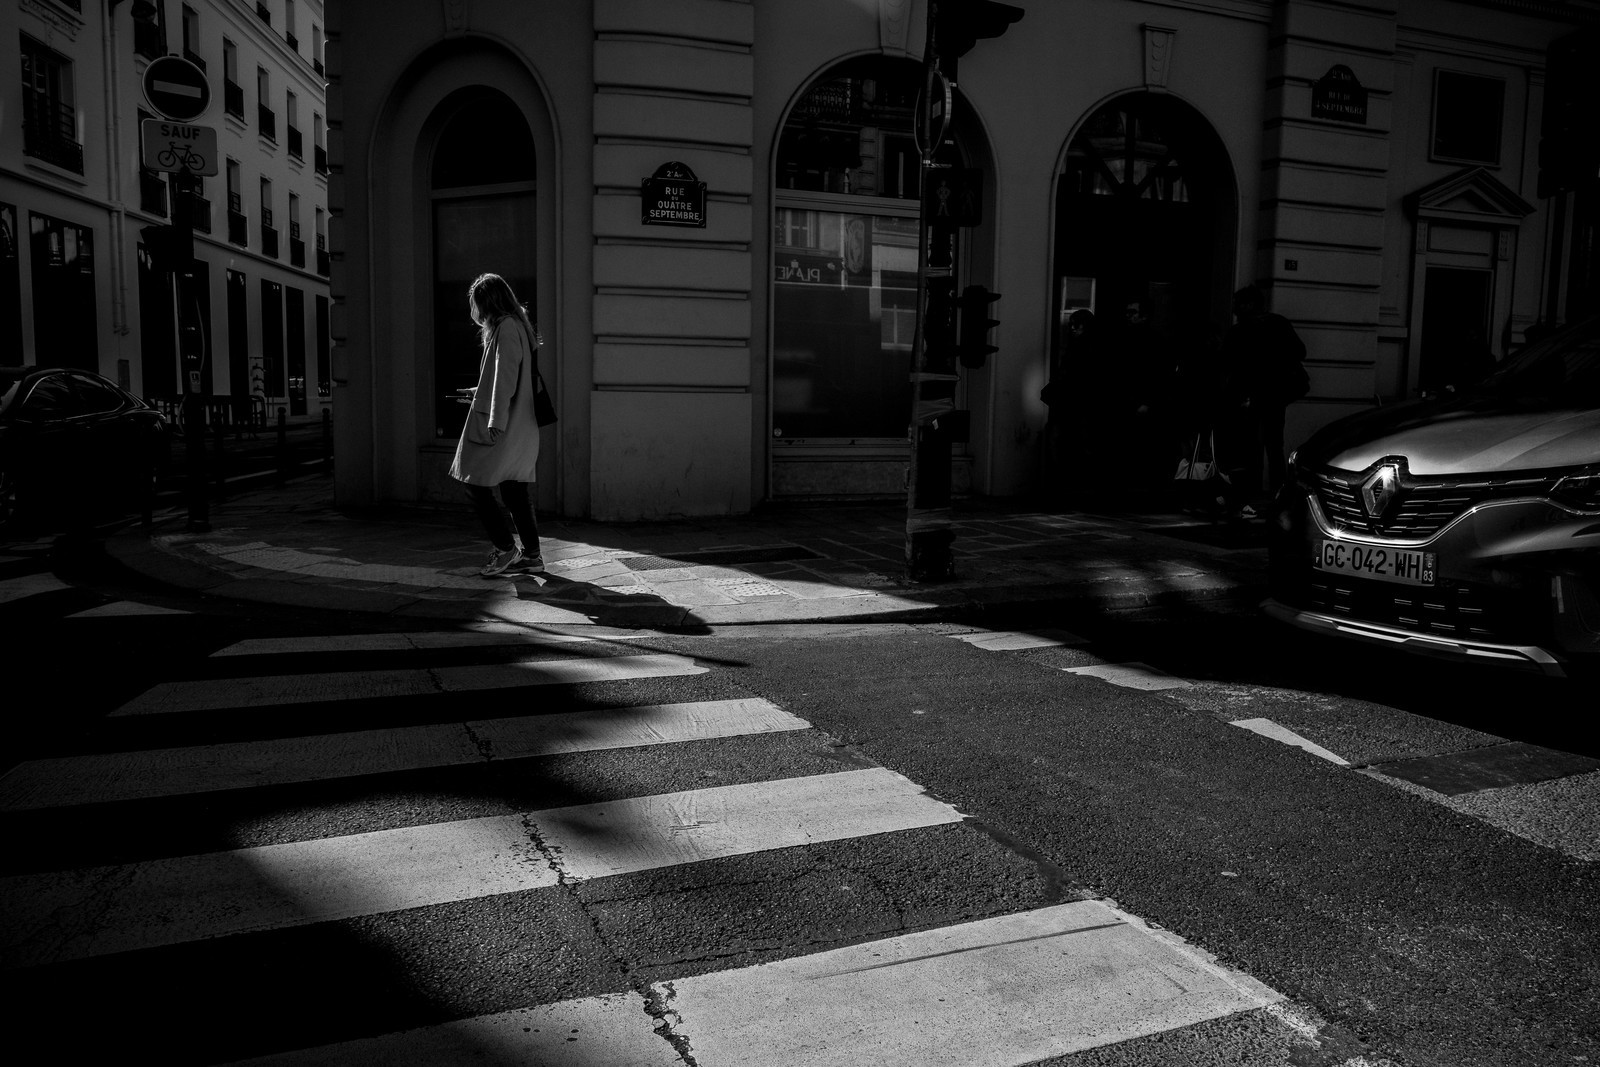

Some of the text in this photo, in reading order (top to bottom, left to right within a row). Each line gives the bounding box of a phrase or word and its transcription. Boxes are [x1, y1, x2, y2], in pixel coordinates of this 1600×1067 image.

[1321, 102, 1364, 116] SEPTEMBRE
[161, 124, 201, 141] SAUF
[665, 186, 685, 196] RUE
[657, 200, 692, 211] QUATRE
[649, 209, 700, 220] SEPTEMBRE
[1324, 543, 1420, 579] GC-042-WH
[1423, 570, 1433, 582] 83
